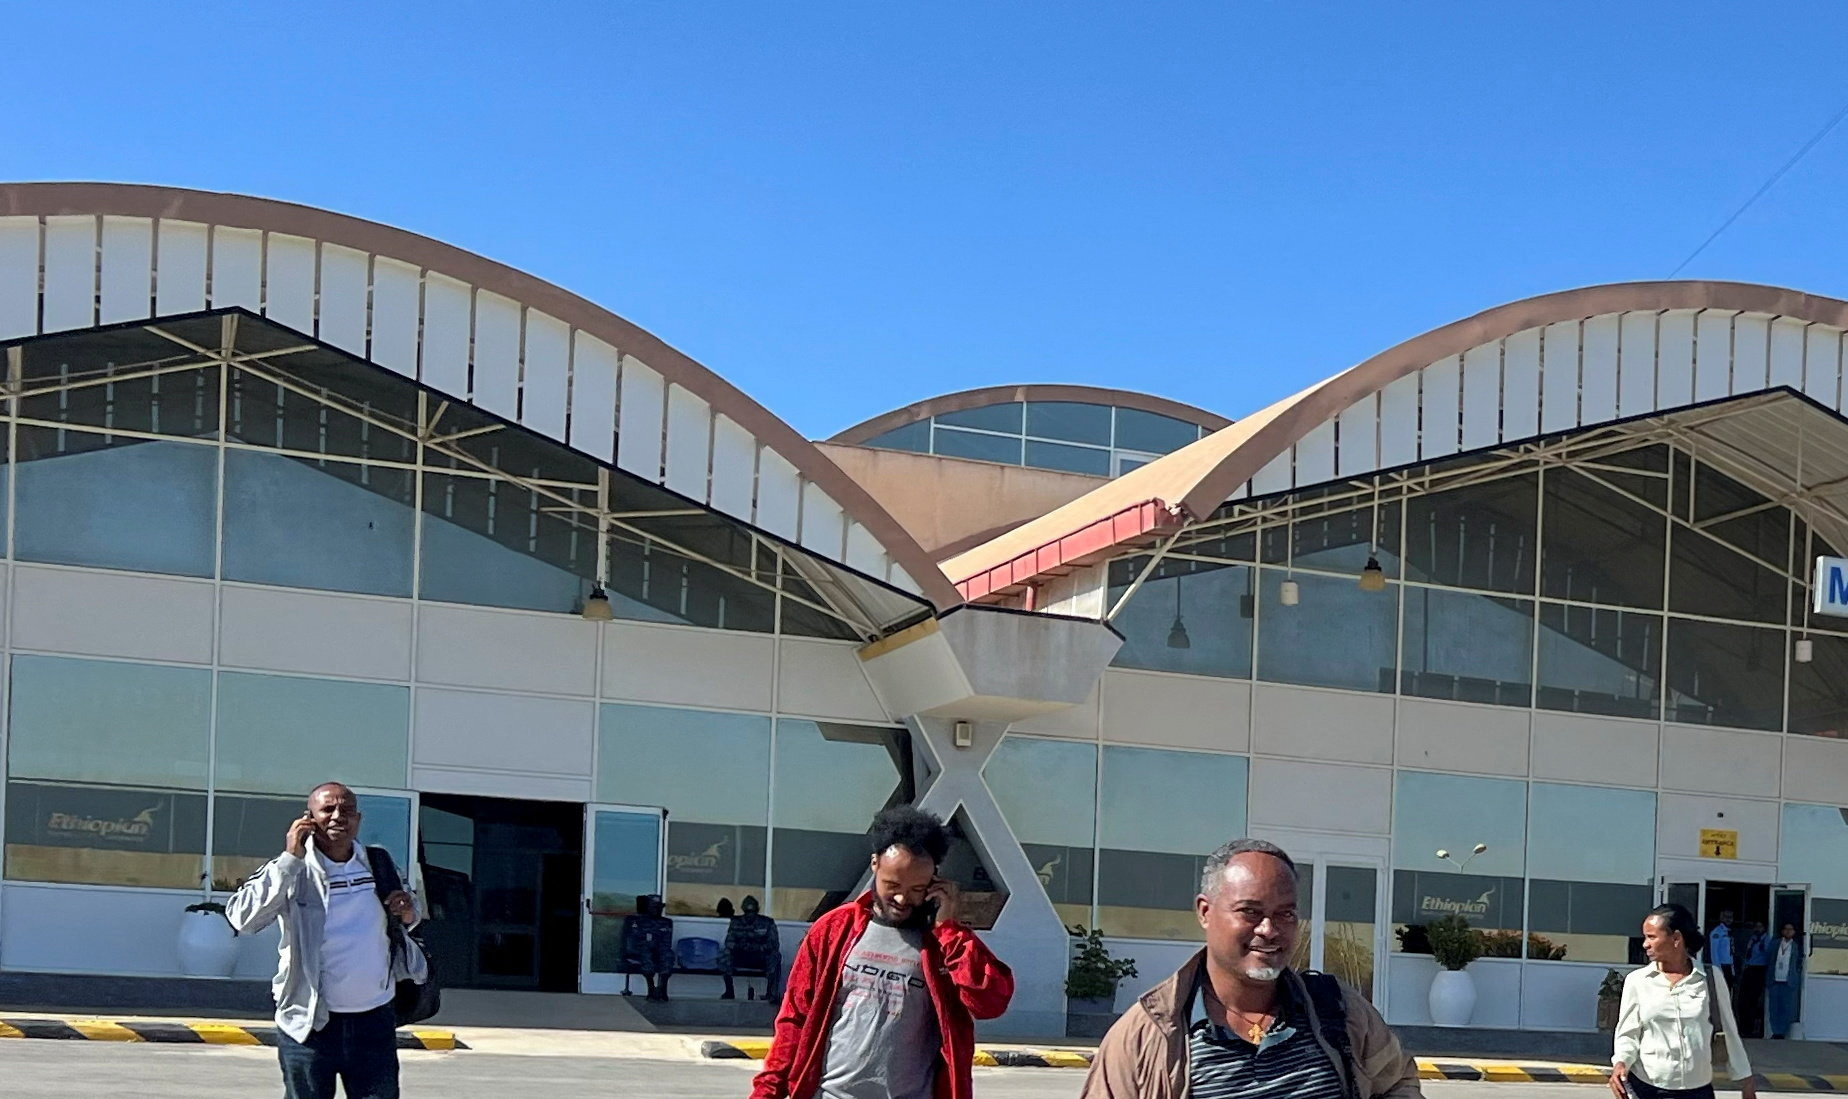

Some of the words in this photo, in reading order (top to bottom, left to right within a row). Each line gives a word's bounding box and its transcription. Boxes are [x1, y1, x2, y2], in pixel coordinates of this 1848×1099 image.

[48, 813, 148, 835] Ethiopian
[667, 853, 717, 869] opian
[1421, 895, 1487, 915] Ethiopian
[844, 963, 926, 989] NDIGO
